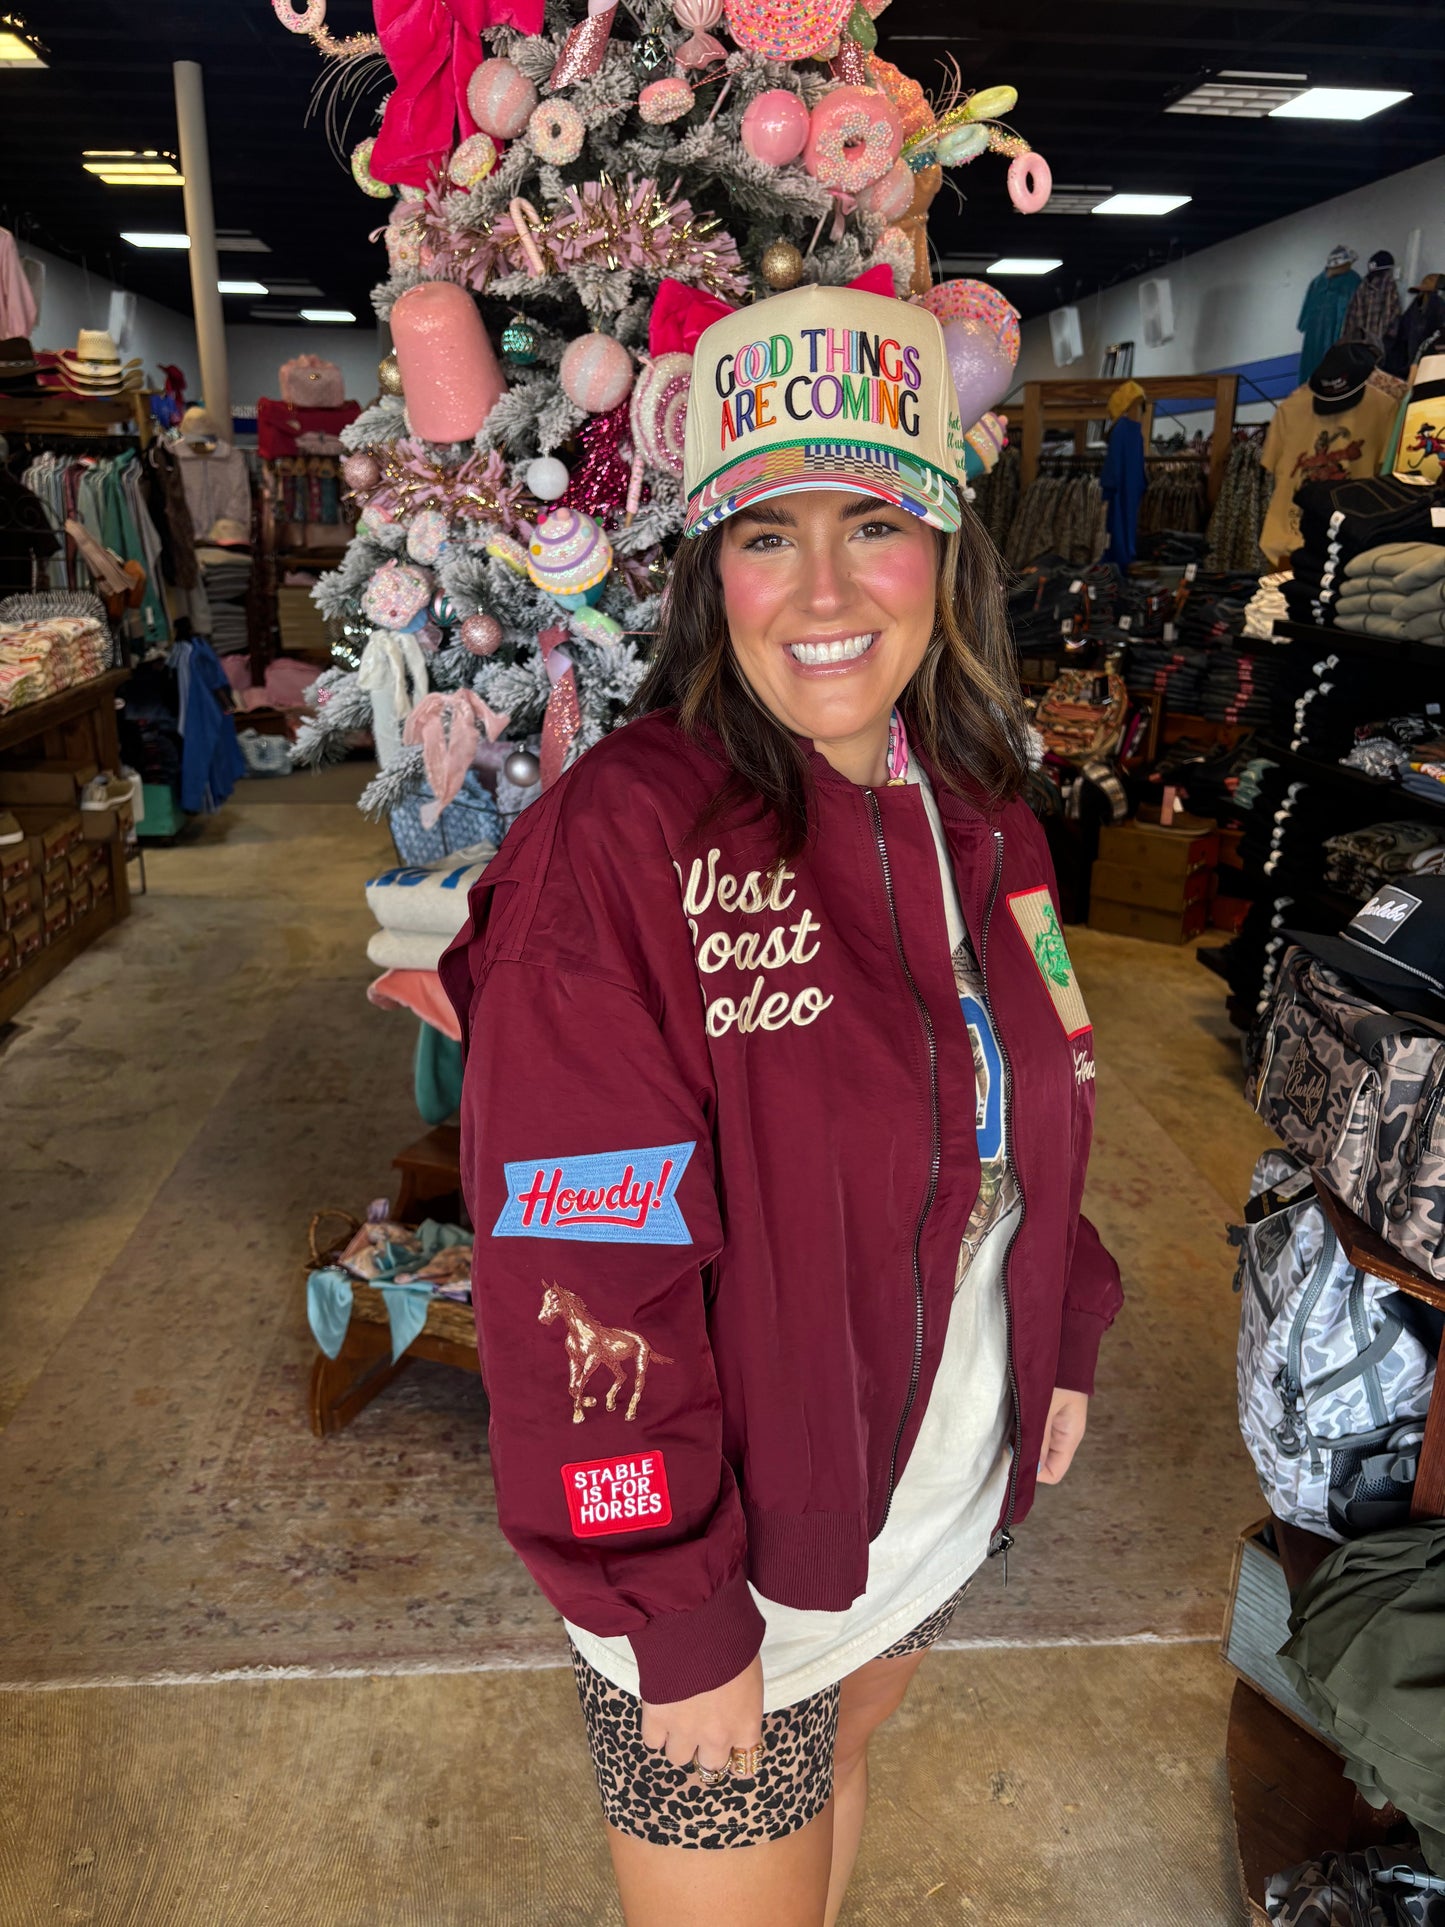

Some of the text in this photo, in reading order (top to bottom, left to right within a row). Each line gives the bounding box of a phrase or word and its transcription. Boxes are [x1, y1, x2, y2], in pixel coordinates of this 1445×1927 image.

[715, 328, 920, 398] GOOD THINGS
[721, 374, 920, 451] ARE COMING
[673, 848, 797, 916] West
[688, 908, 821, 974] oast
[700, 975, 834, 1038] odeo
[517, 1159, 674, 1229] Howdy!
[574, 1458, 654, 1489] STABLE
[583, 1477, 651, 1505] IS FOR
[580, 1493, 662, 1524] HORSES
